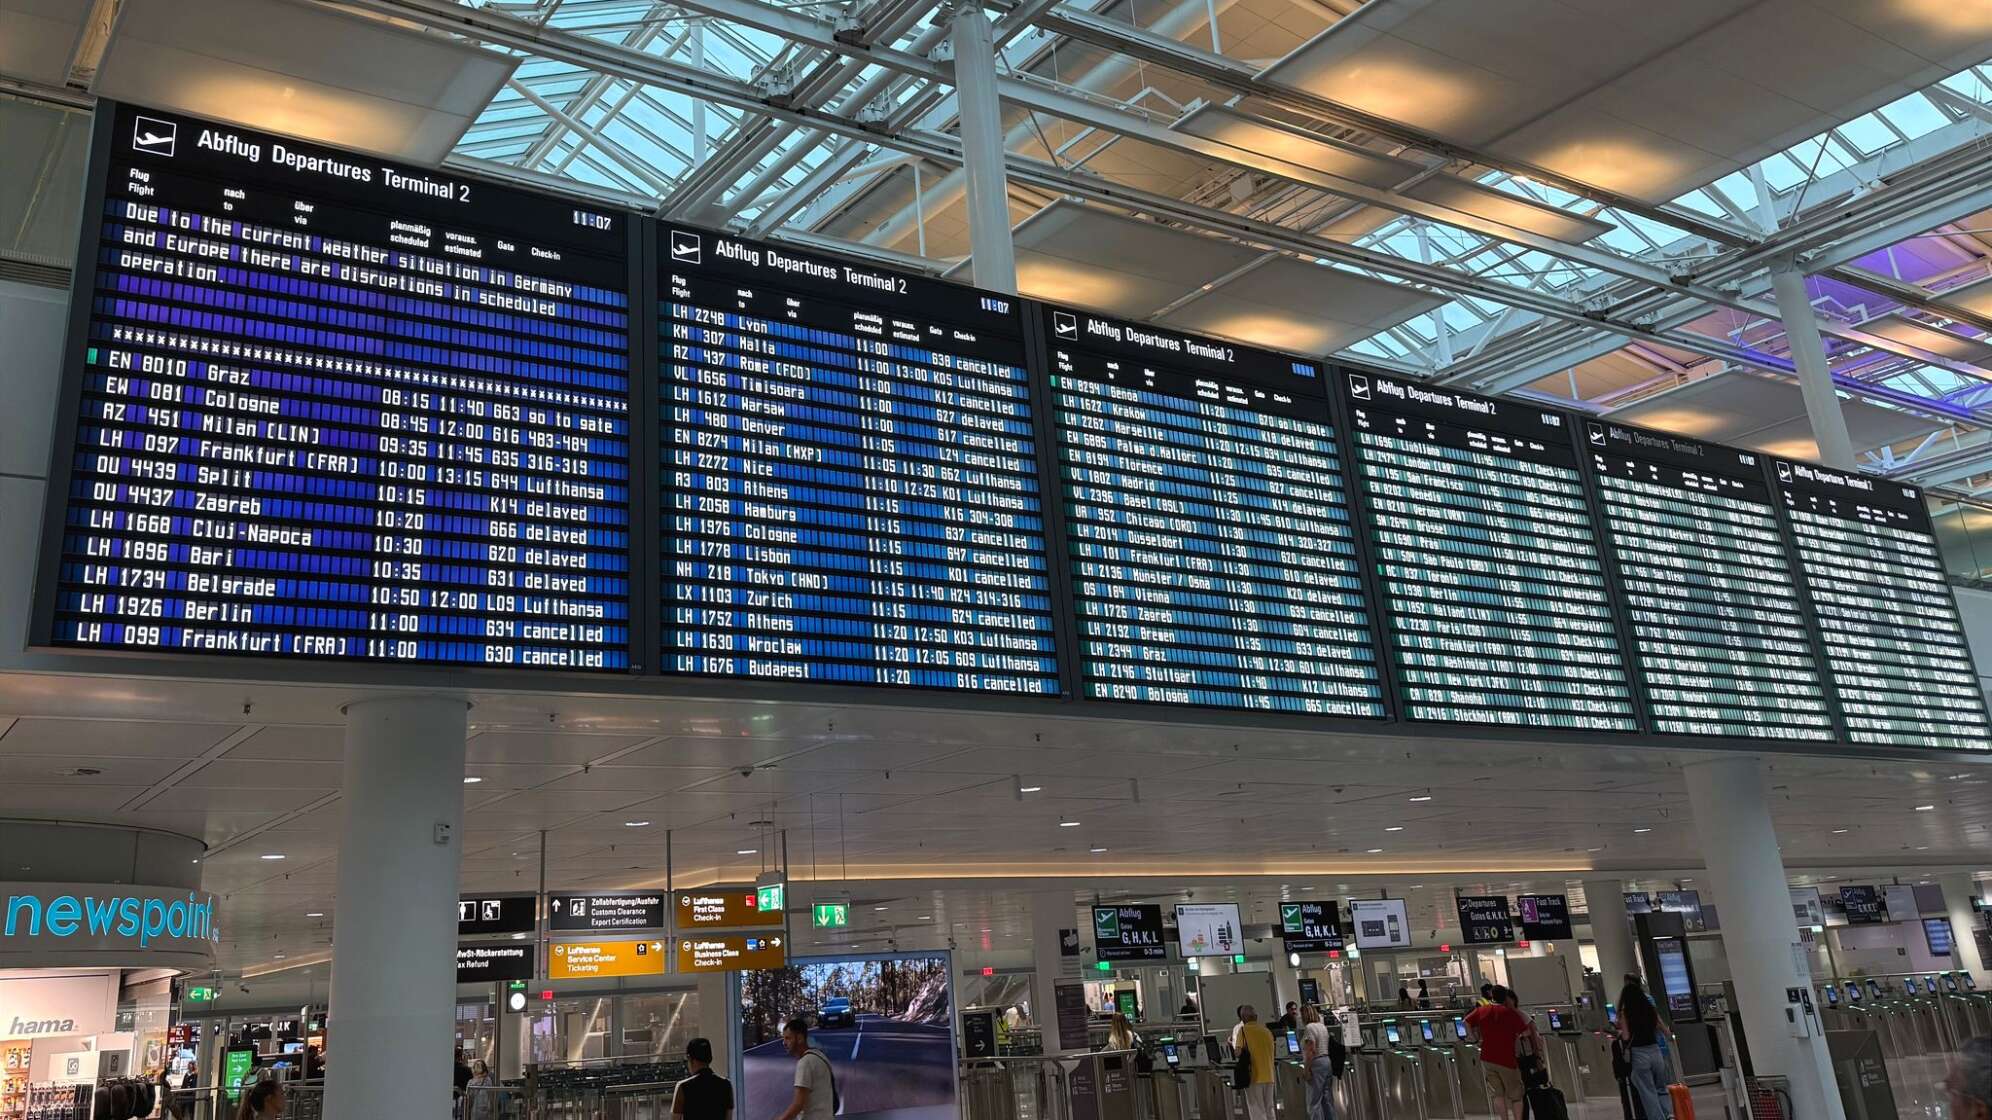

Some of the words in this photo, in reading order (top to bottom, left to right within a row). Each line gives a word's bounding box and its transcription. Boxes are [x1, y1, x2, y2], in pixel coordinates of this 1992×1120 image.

[129, 167, 149, 182] Flug
[197, 129, 260, 162] Abflug
[272, 144, 371, 182] Departures
[381, 167, 453, 199] Terminal
[459, 184, 470, 202] 2
[128, 181, 154, 196] Flight
[223, 201, 233, 211] to
[293, 214, 307, 225] via
[573, 210, 611, 230] 11:07
[126, 202, 158, 223] Due
[171, 210, 190, 229] to
[202, 216, 231, 236] the
[241, 226, 310, 251] current
[322, 241, 388, 264] weather
[398, 255, 479, 281] situation
[489, 269, 505, 286] in
[514, 274, 572, 298] Germany
[389, 233, 429, 248] scheduled
[497, 240, 514, 251] Gate
[531, 246, 560, 260] Check-in
[120, 254, 223, 283] operation.
[123, 229, 156, 247] and
[166, 233, 229, 260] Europe
[241, 247, 291, 270] there
[300, 260, 330, 277] are
[340, 265, 443, 297] disruptions
[454, 285, 469, 301] in
[479, 292, 555, 316] scheduled
[715, 239, 759, 266] Abflug
[767, 250, 837, 279] Departures
[842, 266, 895, 292] Terminal
[898, 278, 907, 294] 2
[980, 297, 1009, 314] 11:07
[1087, 318, 1121, 341] Abflug
[1125, 326, 1180, 351] Departures
[1183, 339, 1225, 360] Terminal
[1226, 348, 1234, 362] 2
[673, 323, 688, 339] KM
[703, 329, 725, 345] 307
[739, 335, 775, 355] Malta
[857, 357, 889, 375] 11:00
[896, 364, 927, 382] 13:00
[932, 370, 952, 386] K05
[957, 375, 1012, 396] Lufthansa
[108, 350, 131, 369] EN
[142, 355, 186, 377] 8010
[207, 364, 249, 386] Graz
[382, 388, 429, 409] 08:15
[439, 396, 484, 416] 11:40
[528, 411, 545, 424] go
[555, 411, 570, 428] to
[579, 417, 612, 433] gate
[1376, 379, 1405, 399] Abflug
[1406, 385, 1453, 406] Departures
[1453, 395, 1489, 413] Terminal
[1488, 402, 1496, 415] 2
[99, 428, 123, 448] LH
[145, 433, 179, 453] 097
[201, 440, 294, 467] Frankfurt
[379, 460, 426, 481] 10:00
[437, 467, 482, 487] 13:15
[527, 476, 604, 500] Lufthansa
[96, 455, 120, 474] OU
[131, 458, 176, 480] 4439
[198, 466, 250, 488] Split
[378, 485, 425, 505] 10:15
[490, 496, 517, 514] K14
[526, 500, 587, 521] delayed
[676, 538, 691, 554] LH
[700, 540, 731, 558] 1778
[745, 545, 790, 564] Lisbon
[869, 558, 902, 576] 11:15
[948, 567, 968, 582] K01
[974, 572, 1031, 589] cancelled
[83, 565, 107, 584] LH
[120, 567, 165, 589] 1734
[188, 573, 275, 597] Belgrade
[371, 586, 419, 606] 10:50
[431, 590, 477, 610] 12:00
[486, 594, 514, 612] L09
[524, 596, 603, 618] Lufthansa
[80, 593, 104, 613] LH
[117, 596, 162, 617] 1926
[186, 600, 251, 623] Berlin
[370, 612, 418, 632] 11:00
[523, 624, 603, 642] cancelled
[592, 908, 616, 916] Customs
[617, 907, 647, 915] Clearance
[694, 905, 708, 913] First
[707, 905, 725, 913] Class
[694, 914, 722, 922] Check-in
[1119, 908, 1142, 919] Abflug
[1302, 904, 1322, 914] Abflug
[4, 890, 212, 948] newspoint
[592, 918, 611, 926] Export
[611, 917, 647, 925] Certification
[467, 960, 489, 968] Refund
[568, 964, 598, 972] Ticketing
[9, 1016, 74, 1035] hama
